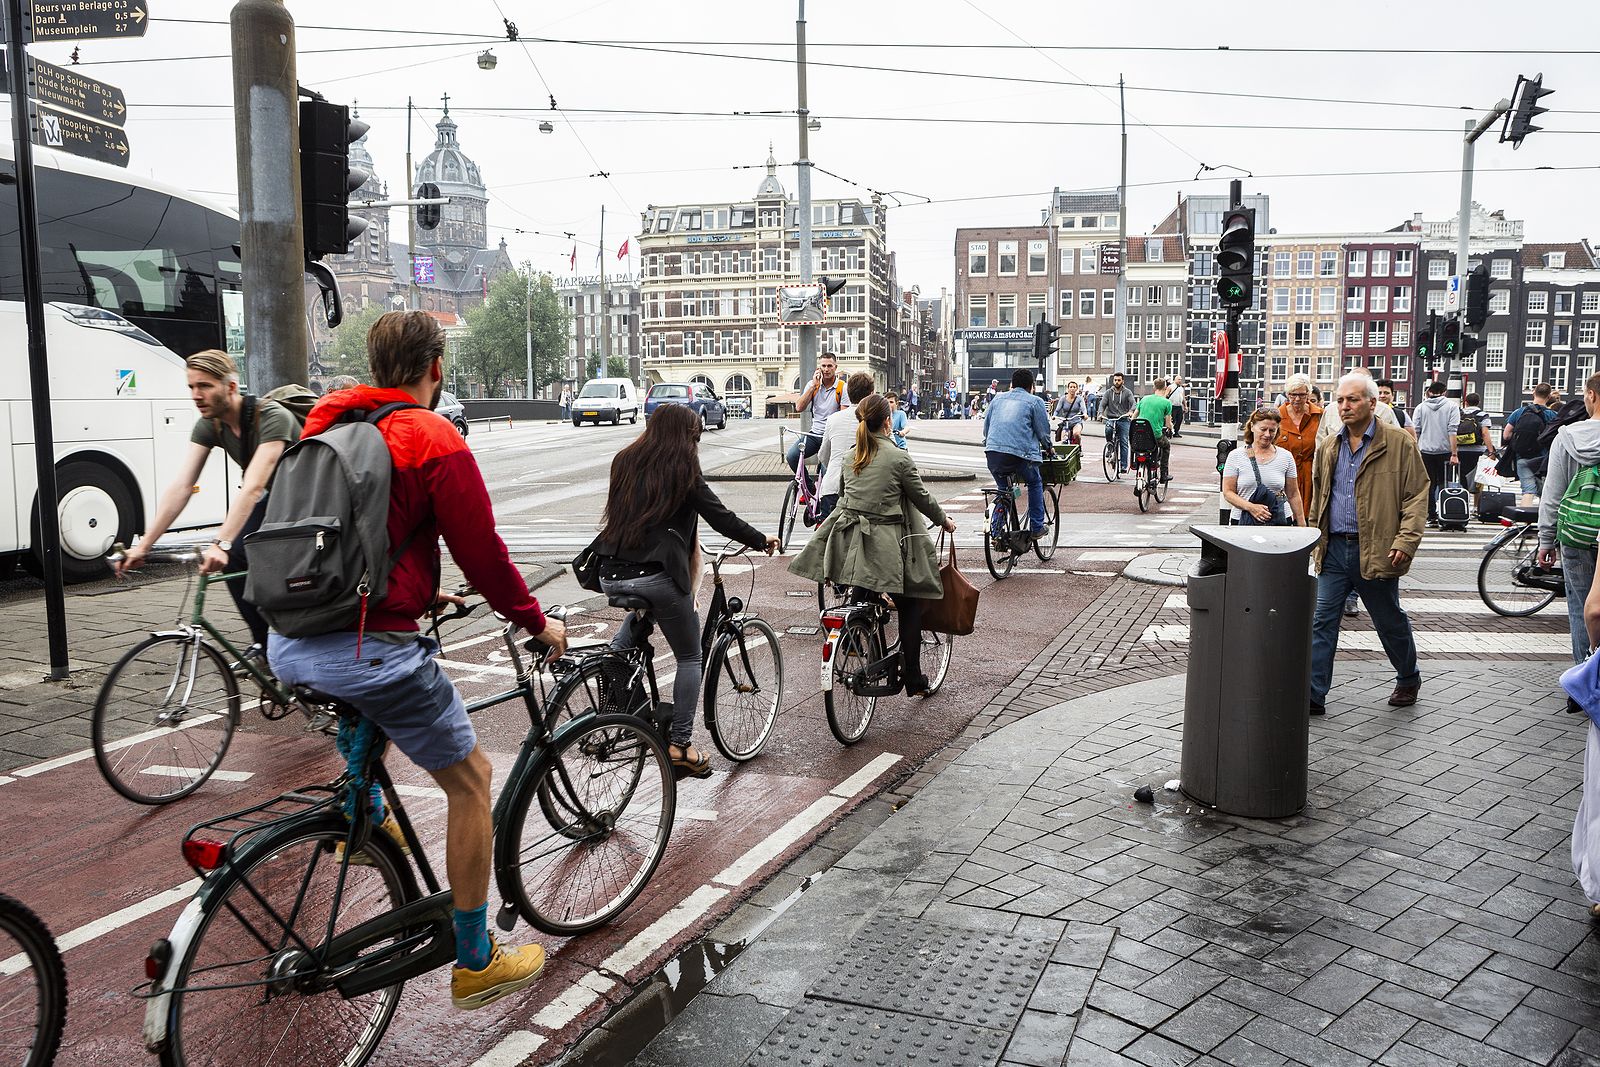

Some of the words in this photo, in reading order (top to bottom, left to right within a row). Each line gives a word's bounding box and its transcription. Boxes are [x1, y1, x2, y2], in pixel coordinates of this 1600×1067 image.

[35, 4, 59, 13] Beurs
[79, 2, 112, 12] Berlage
[35, 15, 56, 24] Dam
[36, 24, 98, 36] Museumplein
[37, 64, 53, 77] OLH
[55, 73, 65, 82] op
[66, 75, 91, 90] Solder
[37, 75, 58, 89] Oude
[60, 83, 77, 95] kerk
[38, 86, 85, 109] Nieuwmarkt
[39, 109, 94, 134] Wrlooplein
